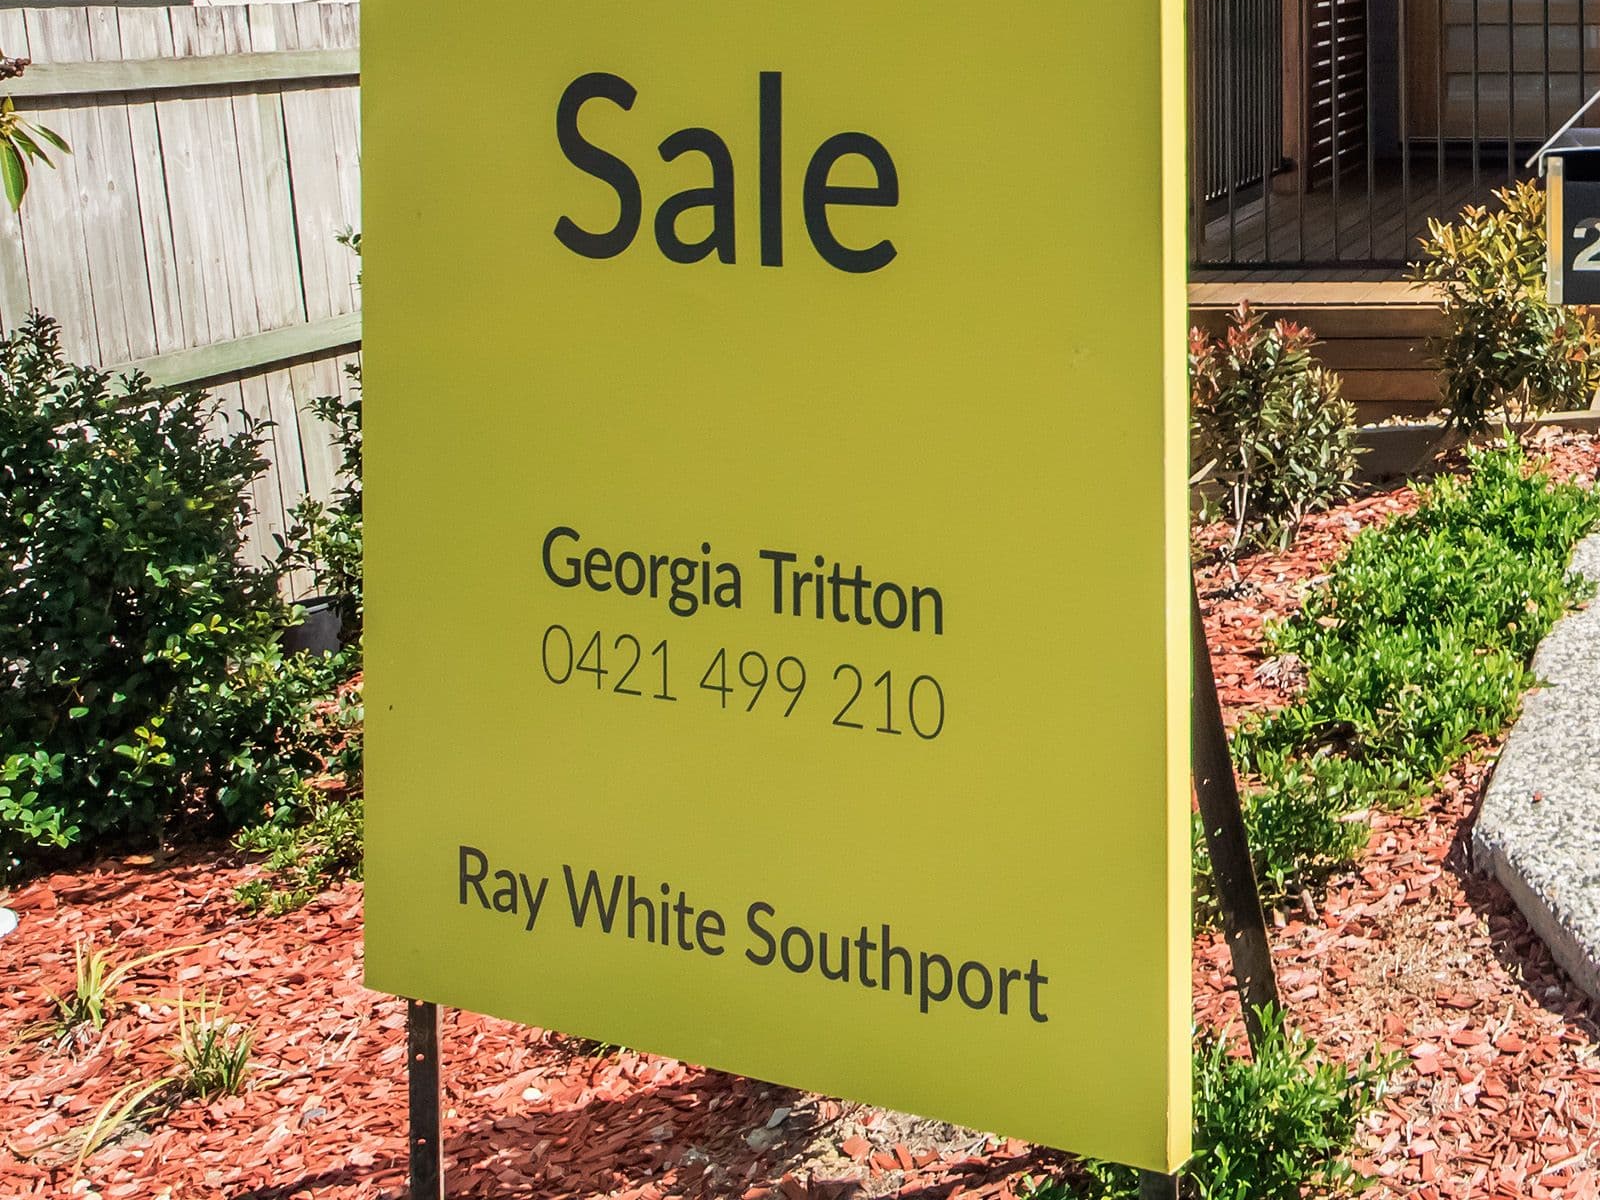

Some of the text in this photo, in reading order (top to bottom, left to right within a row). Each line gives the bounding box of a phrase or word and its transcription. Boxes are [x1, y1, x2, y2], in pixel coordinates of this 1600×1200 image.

[553, 70, 900, 274] Sale
[541, 525, 944, 636] Georgia Tritton
[541, 624, 945, 740] 0421 499 210
[459, 845, 1049, 1024] Ray White Southport
